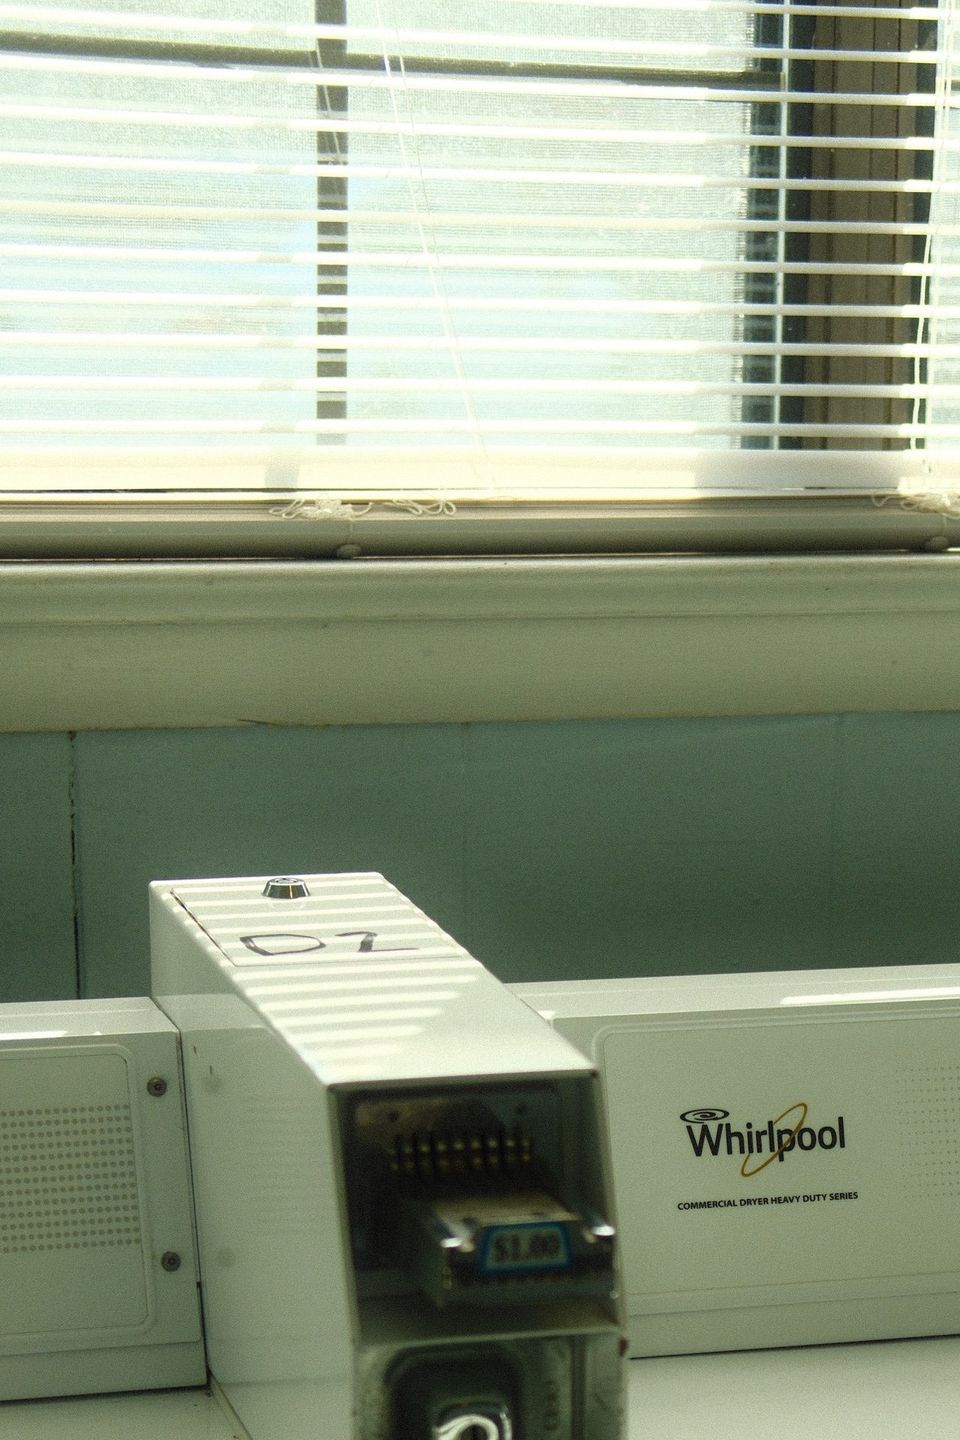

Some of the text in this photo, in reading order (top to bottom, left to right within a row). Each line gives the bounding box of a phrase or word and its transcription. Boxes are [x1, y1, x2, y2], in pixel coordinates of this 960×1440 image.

[686, 1116, 846, 1162] Whirlpool
[677, 1191, 859, 1211] COMMERCIAL DRYER HEAVY DUTY SERIES
